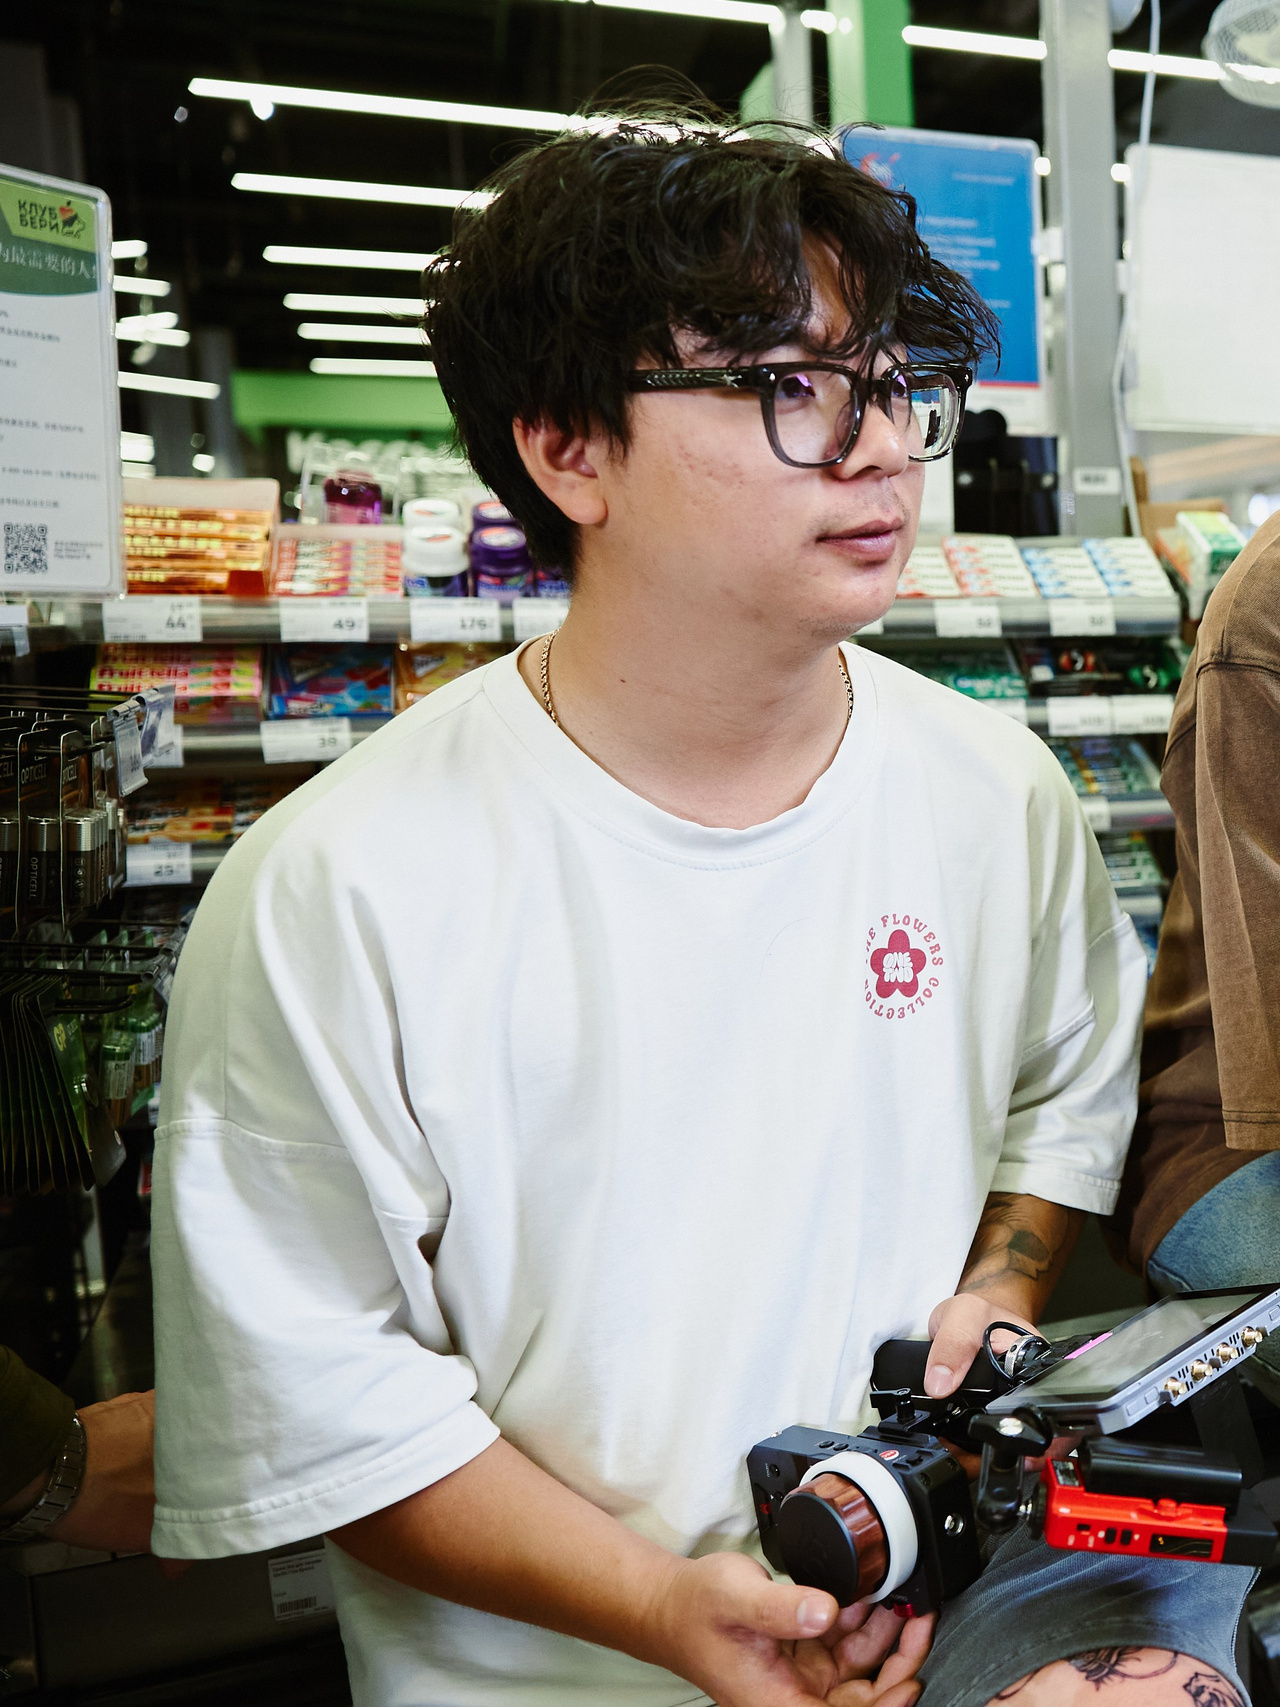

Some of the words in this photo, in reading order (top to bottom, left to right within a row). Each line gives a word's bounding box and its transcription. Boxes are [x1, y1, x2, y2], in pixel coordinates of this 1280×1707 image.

[18, 200, 58, 220] КЛУБ
[20, 213, 59, 233] БЕРИ
[30, 857, 38, 898] OPTICELL
[881, 914, 943, 966] FLOWERS
[883, 951, 913, 968] ONE
